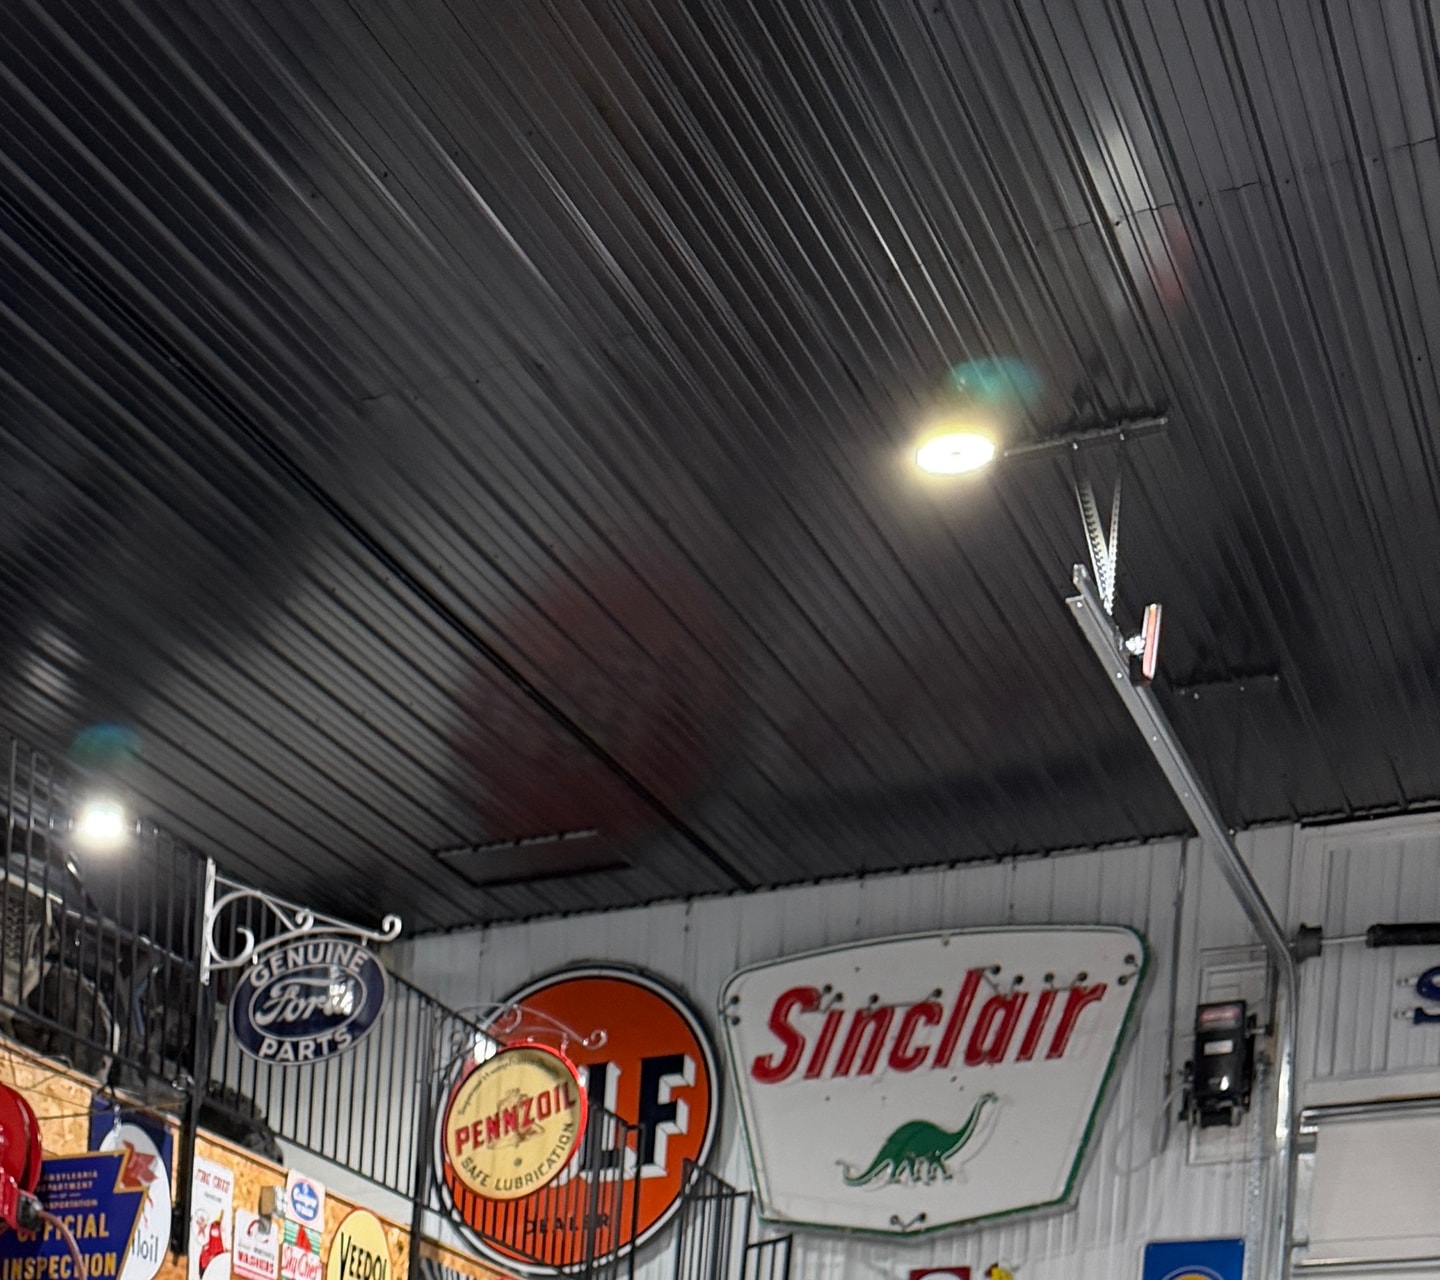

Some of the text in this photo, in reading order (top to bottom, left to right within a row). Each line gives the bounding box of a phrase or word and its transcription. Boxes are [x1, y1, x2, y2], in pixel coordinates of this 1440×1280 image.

[250, 942, 368, 988] GENUINE
[255, 976, 355, 1025] Ford
[751, 967, 1107, 1084] Sinclair
[259, 1027, 352, 1061] PARTS
[454, 1082, 576, 1156] PENNZOIL
[461, 1122, 575, 1192] SAFE LUBRICATION
